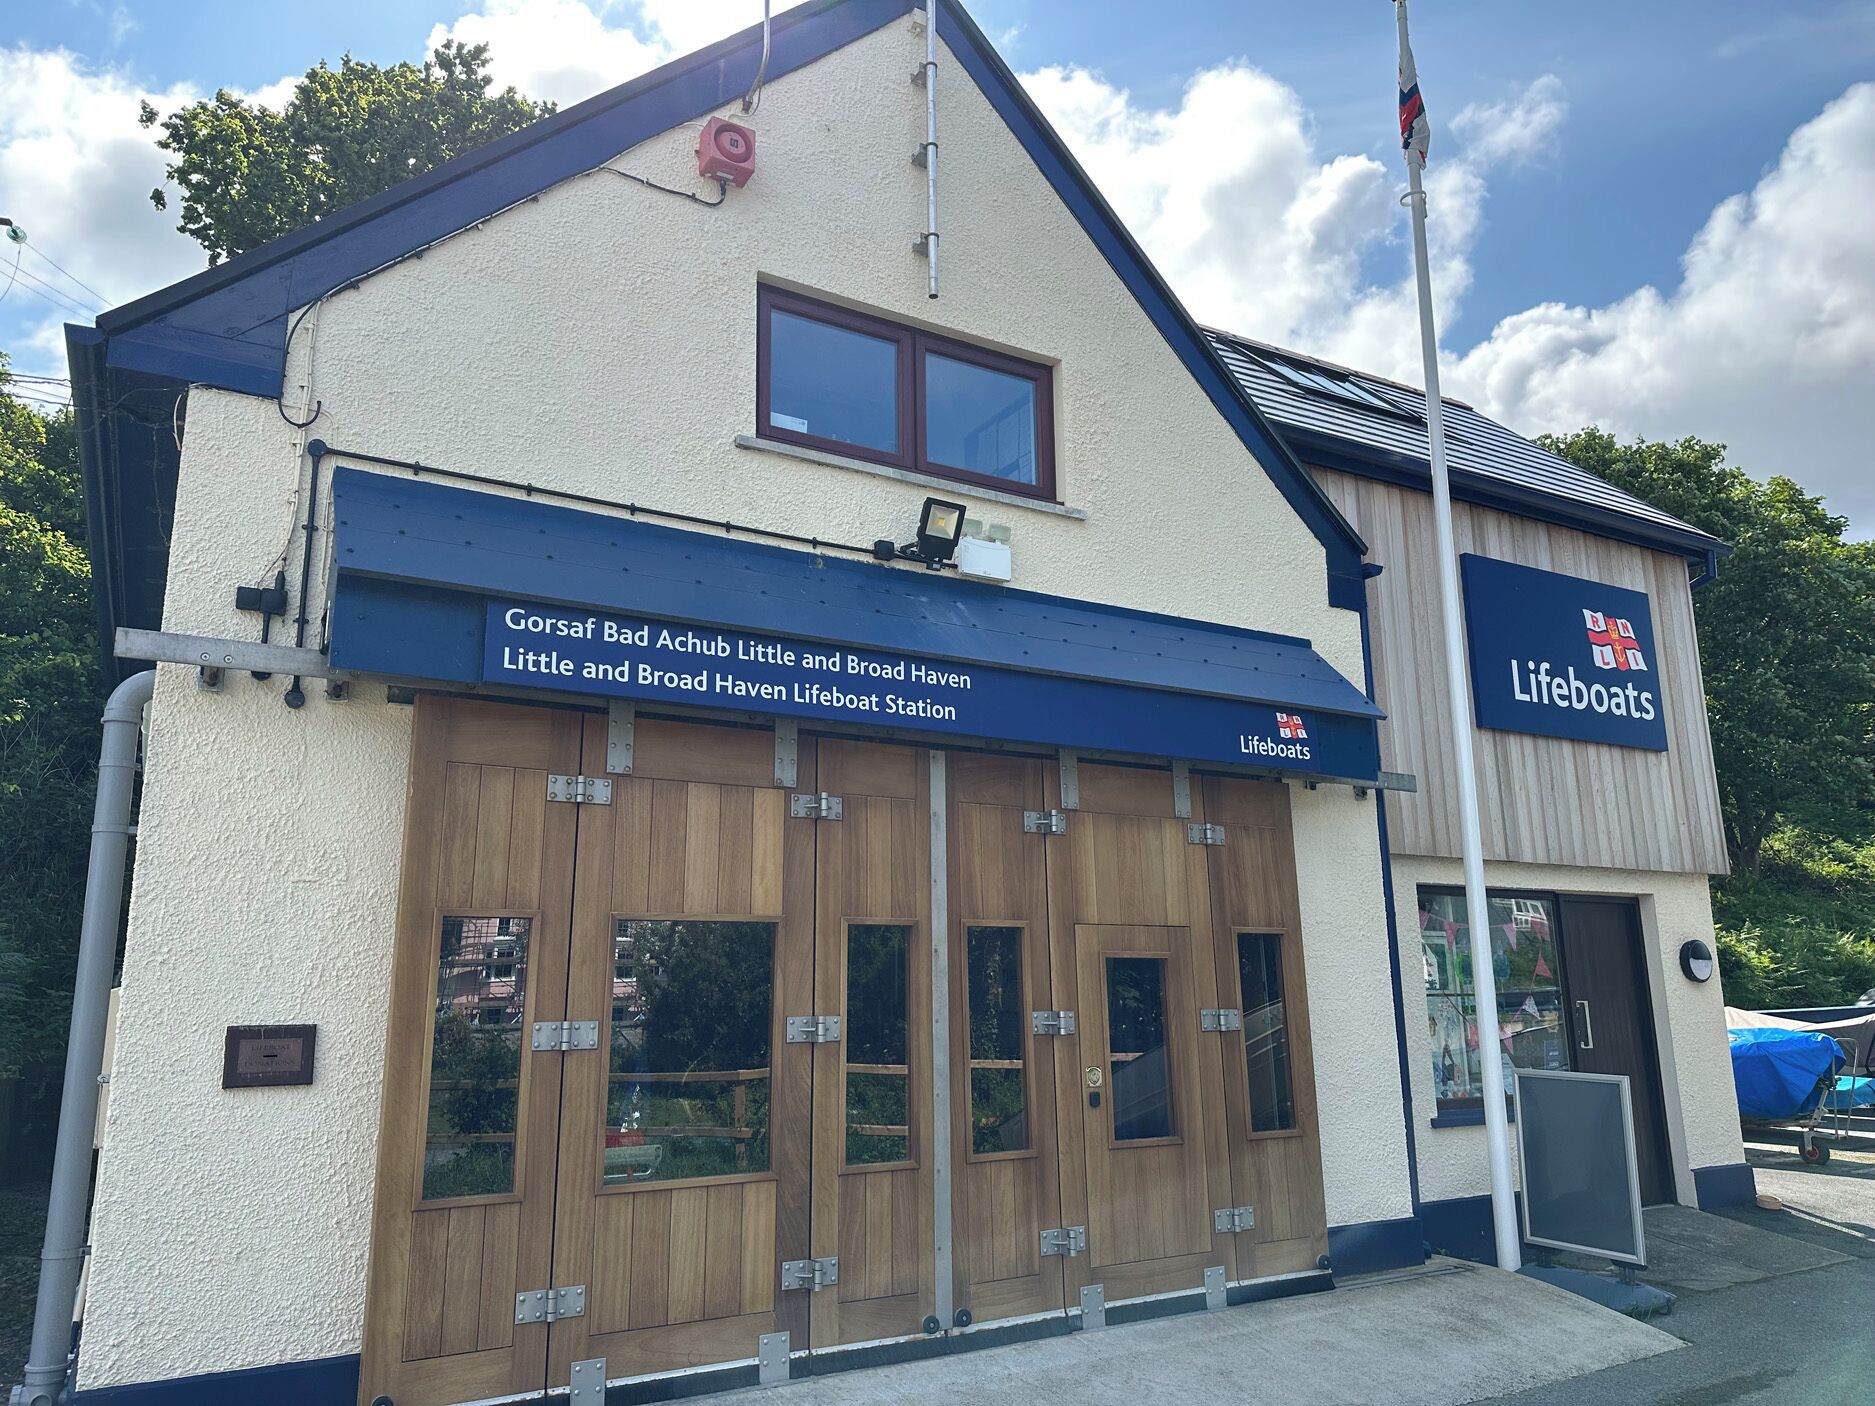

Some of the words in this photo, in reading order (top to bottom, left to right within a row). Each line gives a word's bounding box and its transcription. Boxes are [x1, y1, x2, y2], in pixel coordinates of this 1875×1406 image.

[505, 608, 597, 639] Gorsaf
[604, 620, 649, 647] Bad
[655, 629, 731, 657] Achub
[738, 639, 796, 666] Little
[801, 652, 840, 672] and
[847, 654, 906, 681] Broad
[911, 663, 971, 689] Haven
[503, 646, 574, 676] Little
[582, 660, 630, 683] and
[638, 663, 708, 692] Broad
[715, 673, 787, 701] Haven
[793, 682, 881, 712] Lifeboat
[885, 694, 956, 721] Station
[1510, 658, 1656, 722] Lifeboats
[1240, 735, 1311, 760] Lifeboats
